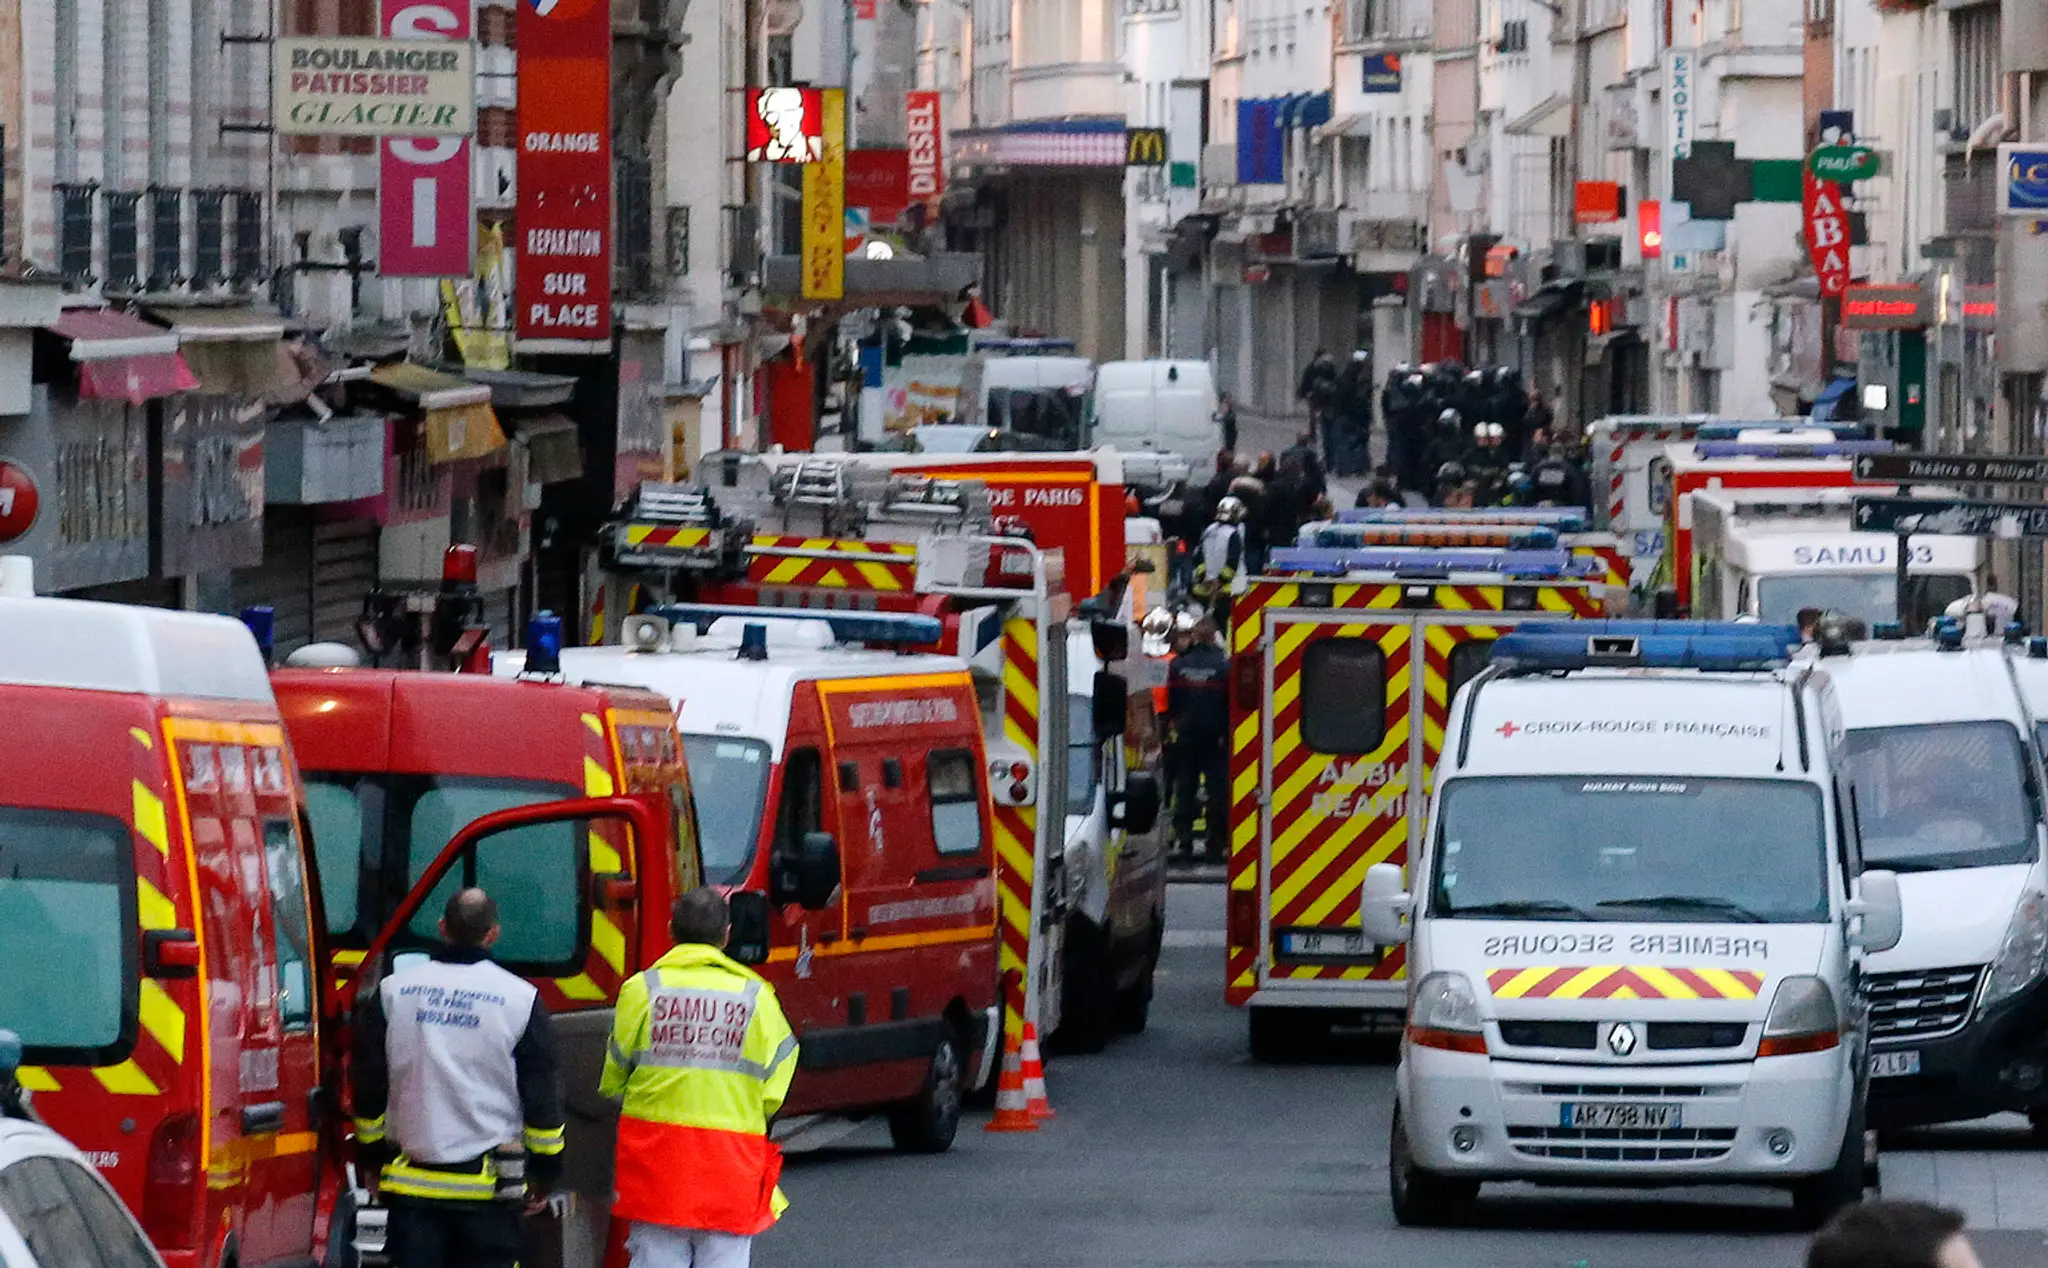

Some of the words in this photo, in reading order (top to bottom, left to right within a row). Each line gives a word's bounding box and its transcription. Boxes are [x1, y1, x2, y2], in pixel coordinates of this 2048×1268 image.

[291, 48, 458, 71] BOULANGER
[291, 72, 428, 95] PATISSIER
[289, 101, 457, 127] GLACIER
[525, 132, 600, 152] ORANGE
[909, 102, 936, 194] DIESEL
[1817, 153, 1850, 171] PMU
[527, 229, 601, 255] REPARATION
[543, 272, 586, 295] SUR
[531, 304, 599, 326] PLACE
[988, 488, 1015, 506] DE
[1025, 488, 1084, 506] PARIS
[1794, 546, 1887, 564] SAMU
[1524, 720, 1657, 736] CROIX-ROUGE
[655, 995, 717, 1022] SAMU
[724, 1001, 747, 1027] 93
[652, 1023, 745, 1048] MEDECIN
[1574, 1106, 1599, 1126] AR
[1603, 1105, 1639, 1126] 798
[1642, 1106, 1668, 1126] NV
